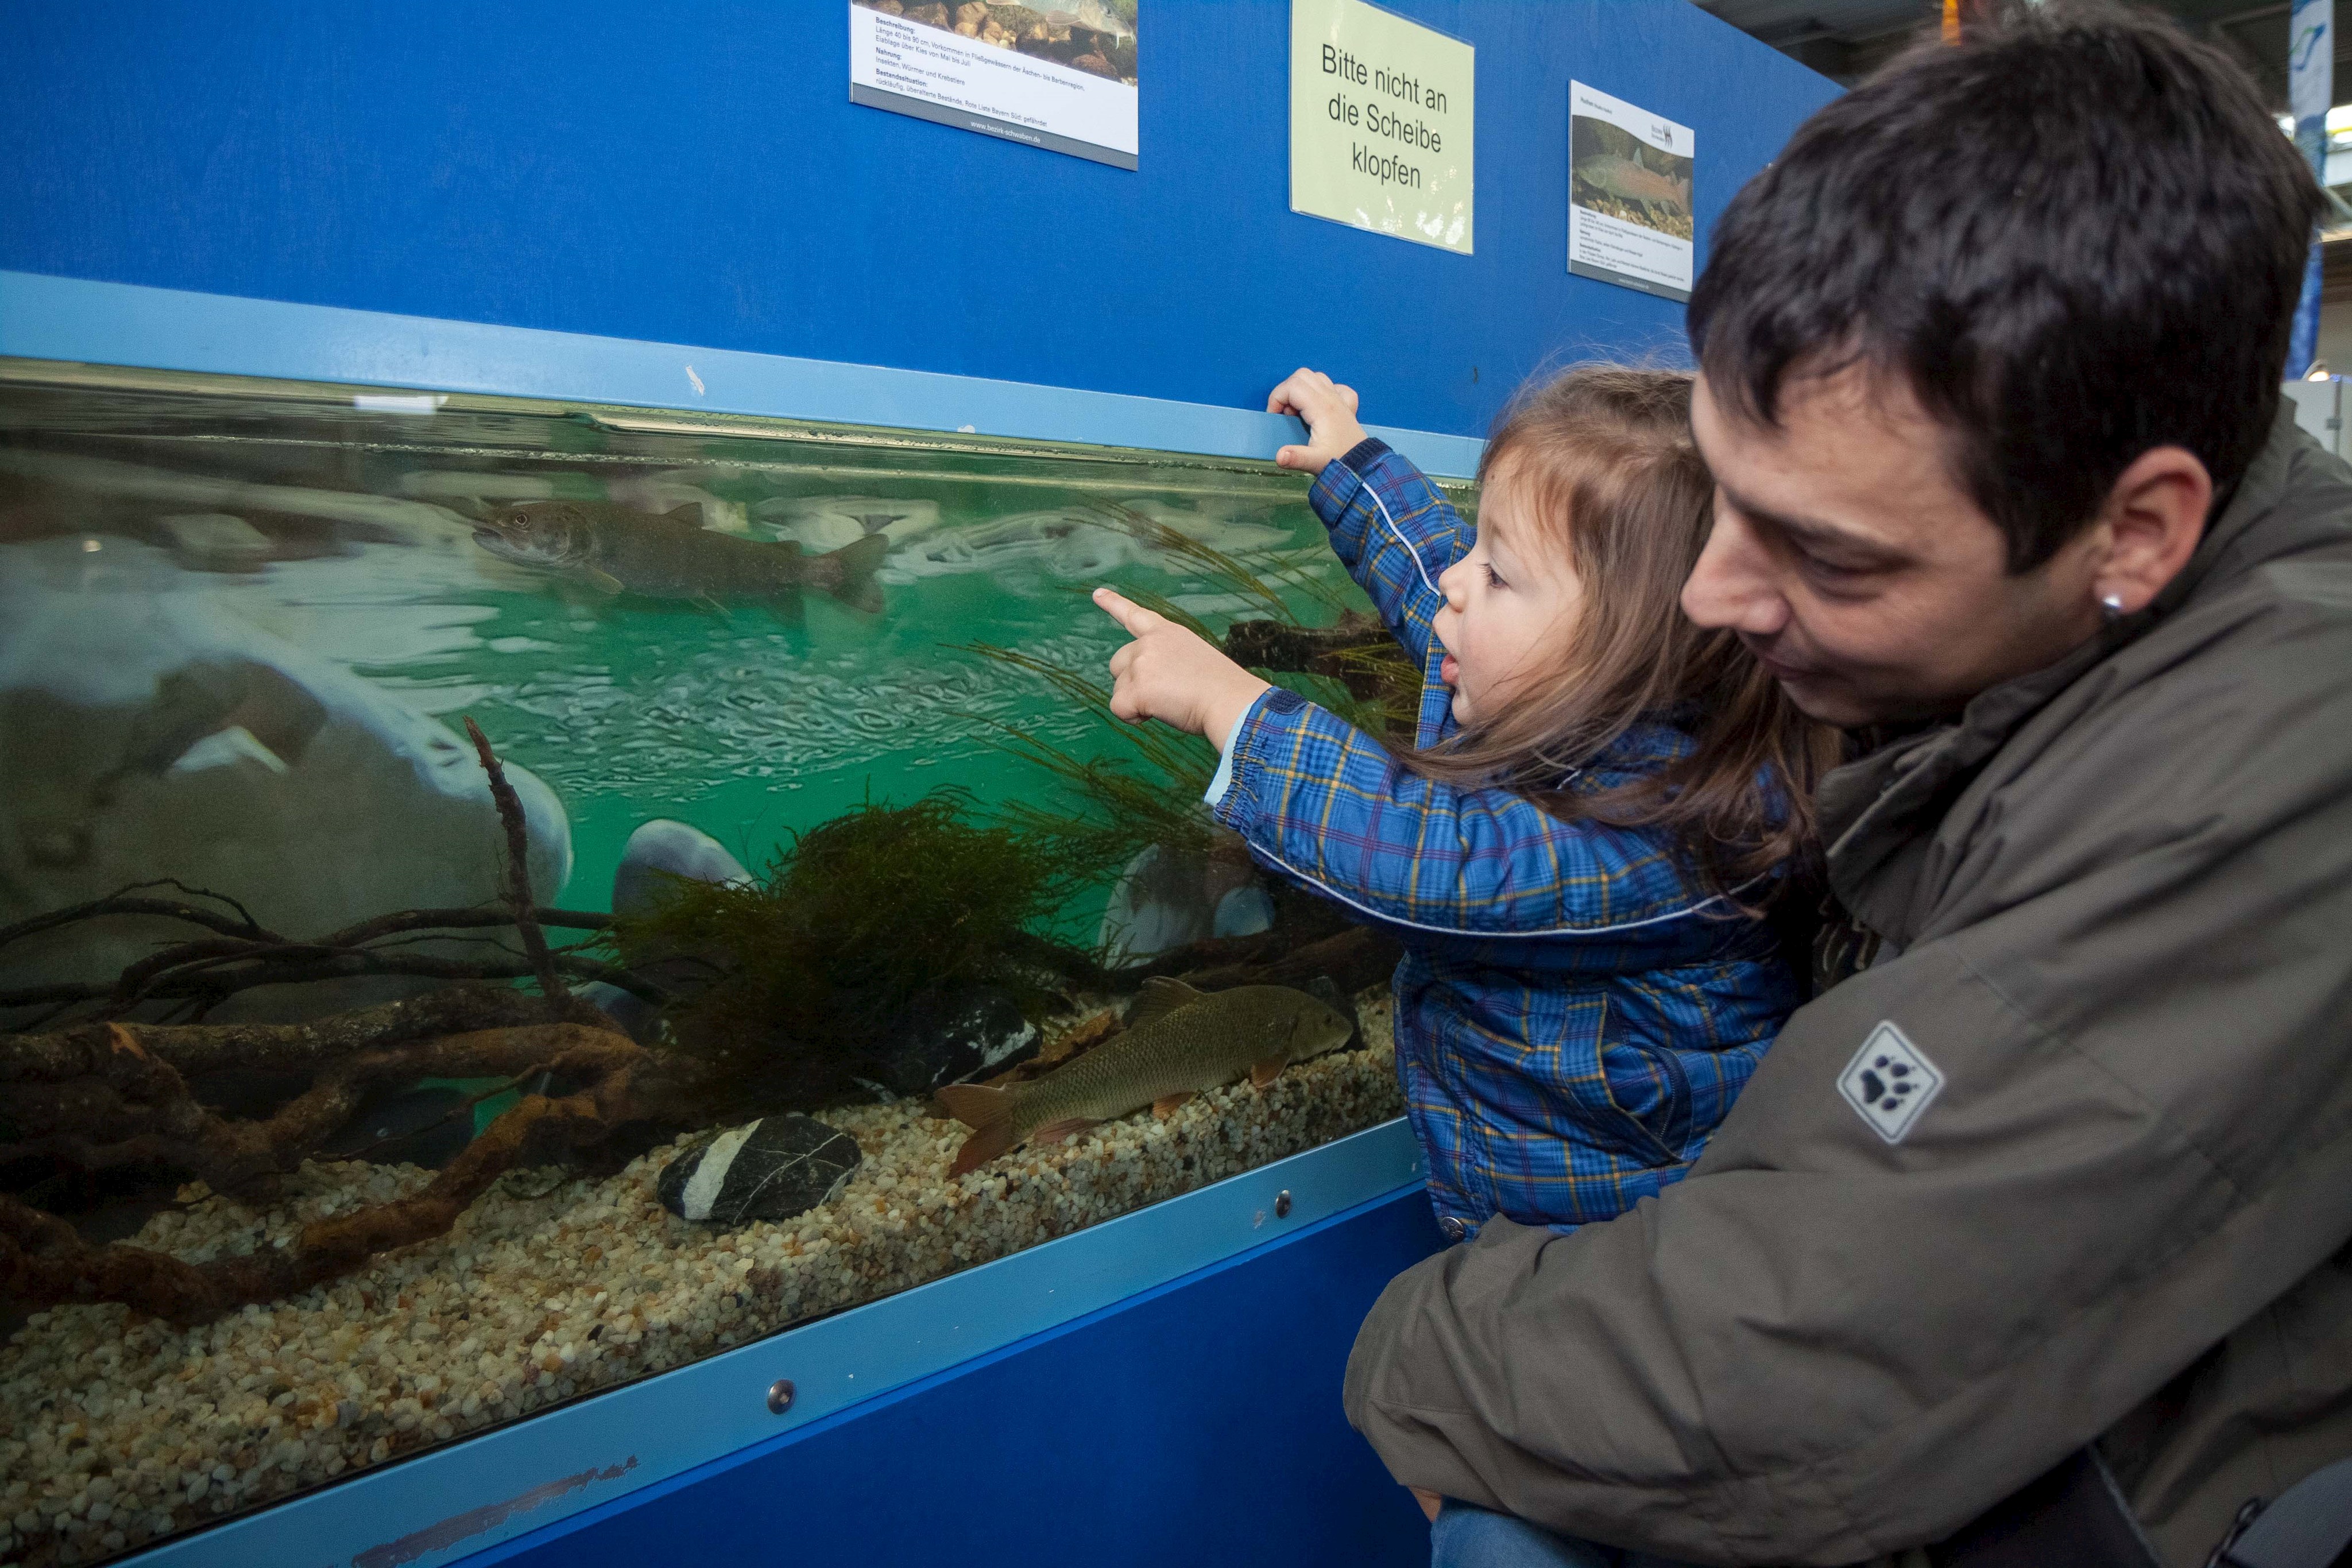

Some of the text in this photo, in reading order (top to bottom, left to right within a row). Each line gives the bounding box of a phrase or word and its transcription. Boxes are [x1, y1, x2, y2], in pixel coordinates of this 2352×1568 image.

[876, 17, 915, 34] Beschreibung:
[876, 35, 900, 48] Eiablage
[902, 42, 914, 51] über
[916, 46, 927, 55] Kies
[941, 53, 950, 61] Mai
[951, 56, 960, 64] bis
[961, 58, 971, 67] Juli
[876, 47, 902, 60] Nahrung:
[876, 26, 893, 37] Länge
[931, 41, 964, 56] Vorkommen
[972, 53, 1011, 69] Fließgewässern
[1022, 66, 1042, 78] Äschen-
[1051, 76, 1085, 91] Barbenregion,
[876, 56, 965, 86] Insekten, Würmer und Krebstiere
[876, 68, 928, 87] Bestandssituation:
[1322, 43, 1446, 114] Bitte nicht an
[876, 78, 1047, 127] rückläufig, überalterte Bestände, Rote Liste Bayern Süd: gefährdet
[970, 121, 1041, 144] www.bezirk-schwaben.de
[1329, 93, 1441, 153] die Scheibe
[1352, 142, 1421, 189] klopfen
